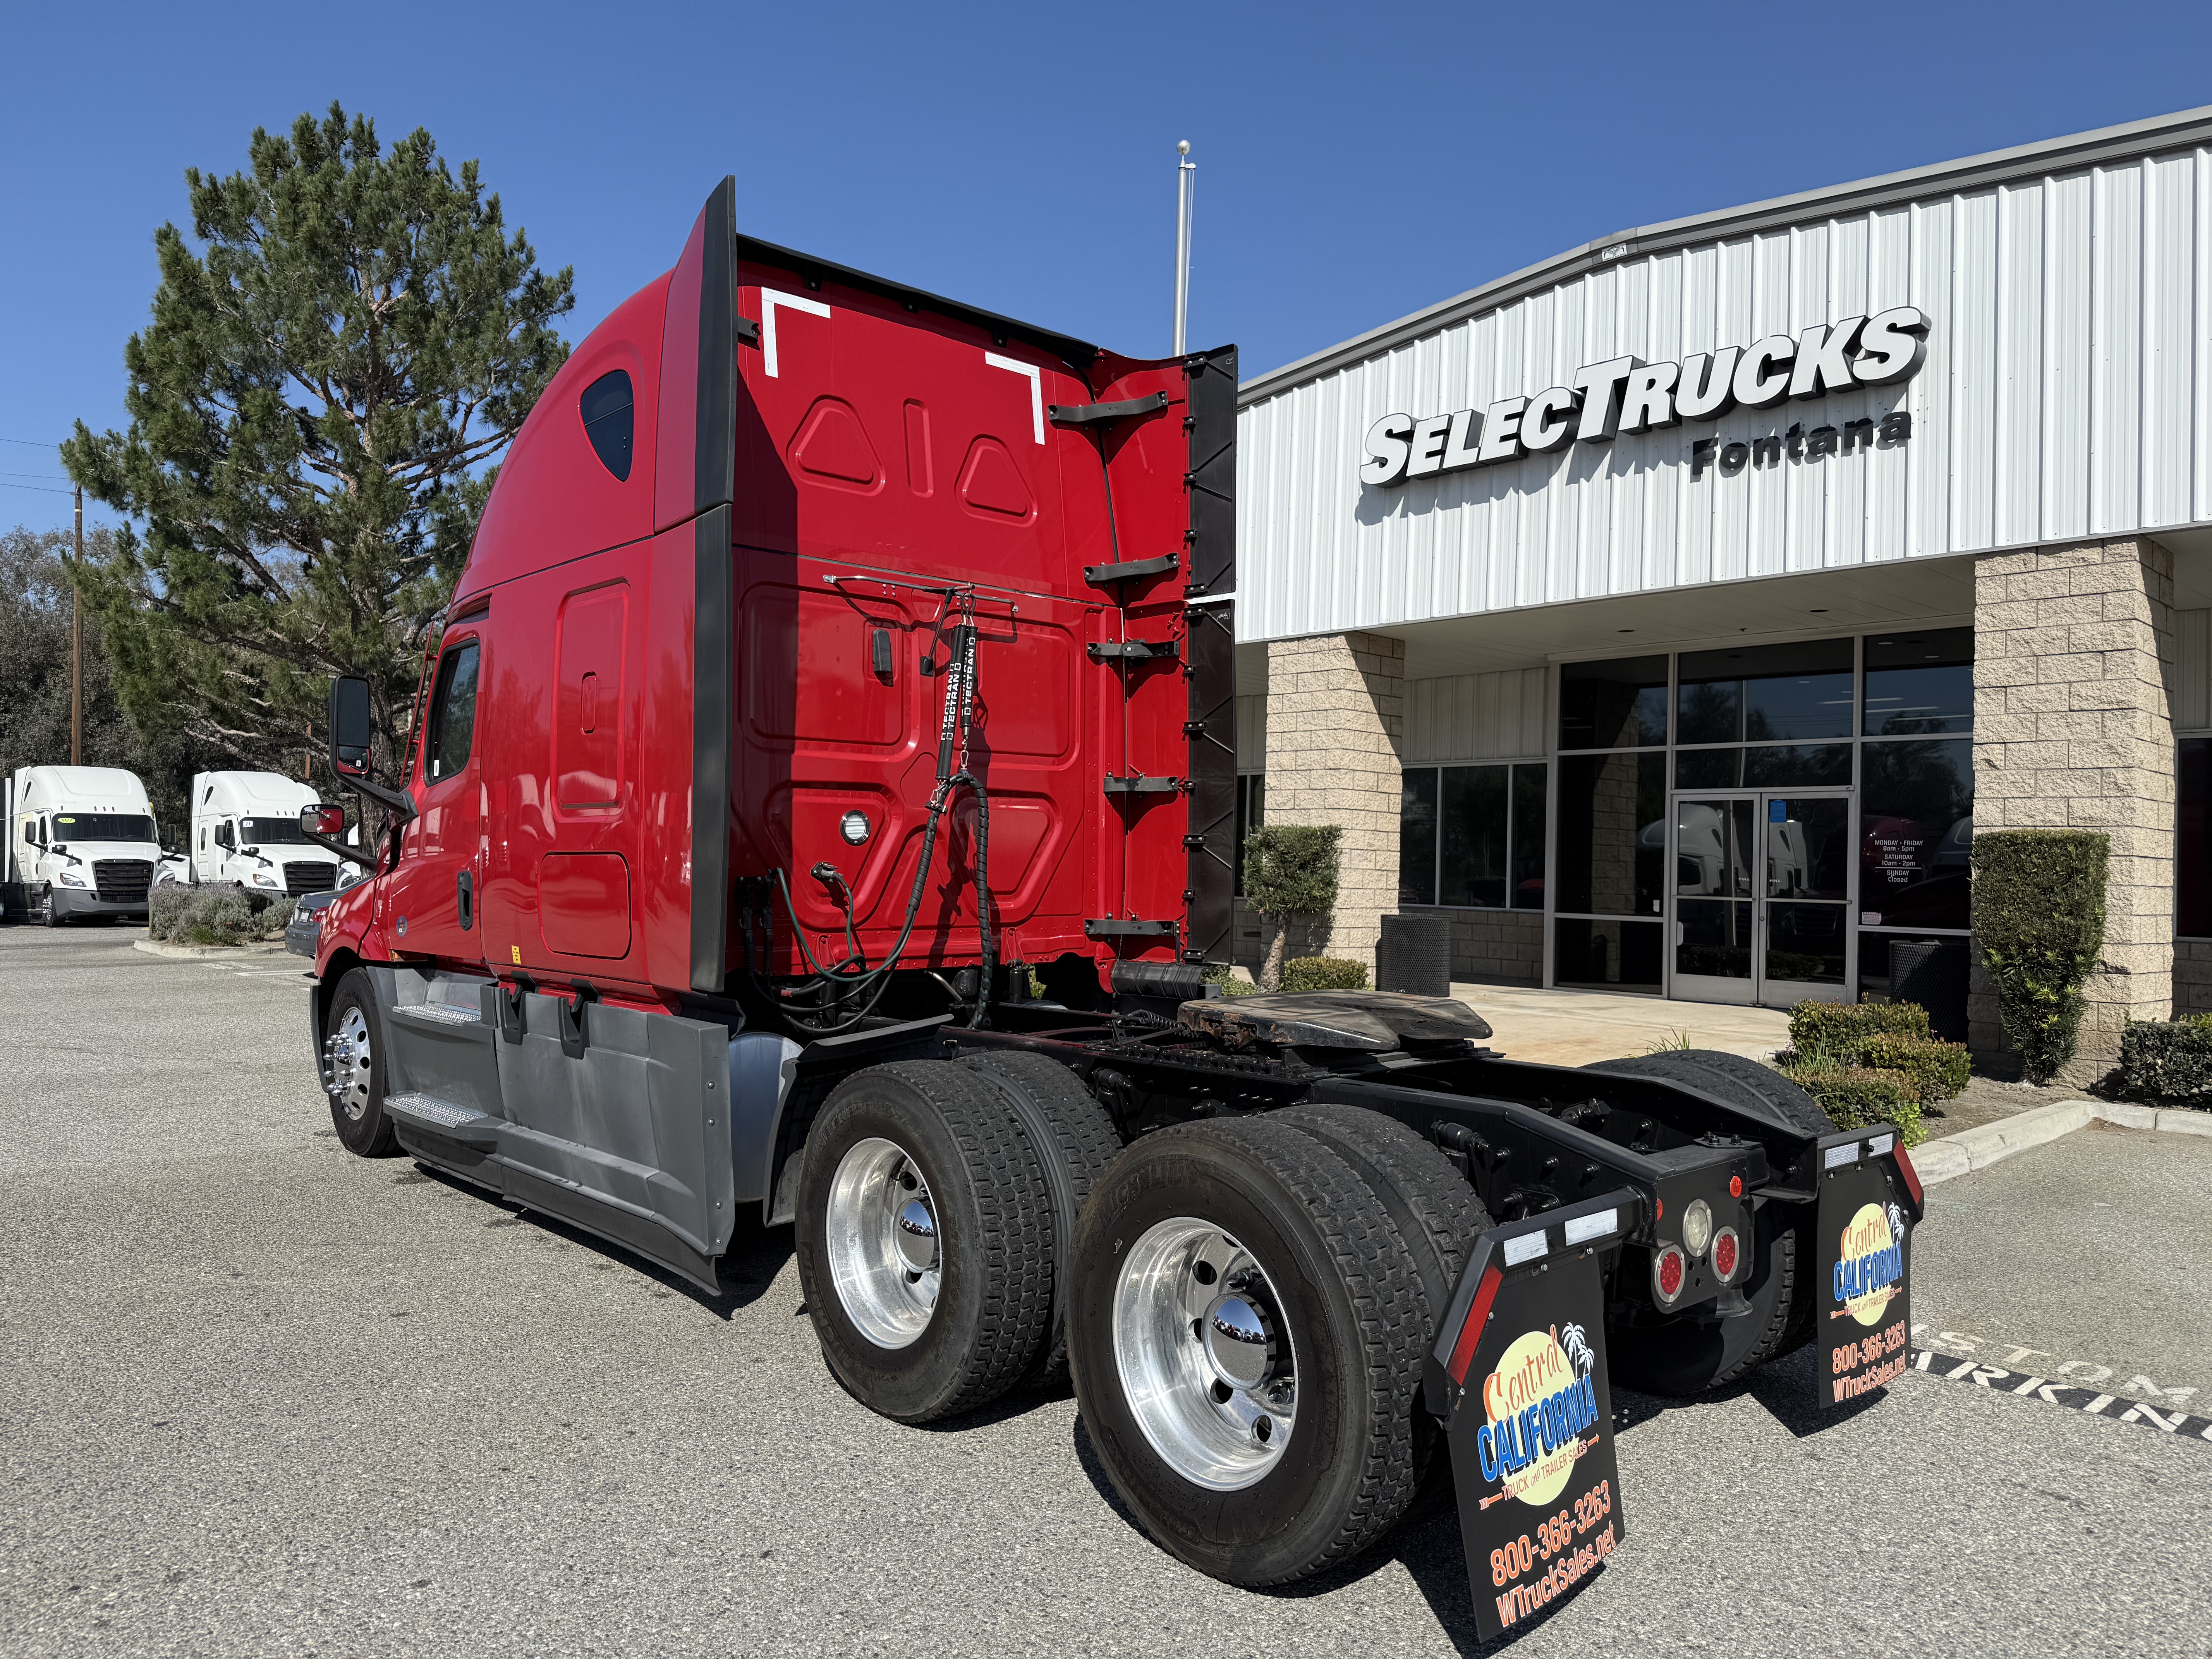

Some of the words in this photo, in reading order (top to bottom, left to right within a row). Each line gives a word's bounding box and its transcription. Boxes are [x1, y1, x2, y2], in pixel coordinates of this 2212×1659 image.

[1360, 307, 1932, 488] SELECTRUCKS
[1692, 411, 1911, 475] Fontana
[948, 674, 960, 729] TECTRAN
[965, 649, 974, 704] TECTRAN
[1841, 1201, 1886, 1262] Central
[1834, 1242, 1903, 1301] CALIFORNIA
[1844, 1302, 1860, 1316] TRUCK
[1869, 1294, 1884, 1308] TRAILER
[1884, 1287, 1895, 1300] SALES
[1483, 1324, 1563, 1423] Central
[1832, 1320, 1906, 1374] 800-366-3263
[1833, 1350, 1906, 1402] WTruckSales.net
[1477, 1373, 1599, 1482] CALIFORNIA
[1501, 1477, 1529, 1501] TRUCK
[1530, 1464, 1541, 1487] and
[1540, 1455, 1568, 1479] TRAILER
[1568, 1439, 1588, 1462] SALES
[1491, 1479, 1611, 1587] 800-366-3263
[1496, 1520, 1616, 1628] WTruckSales.net
